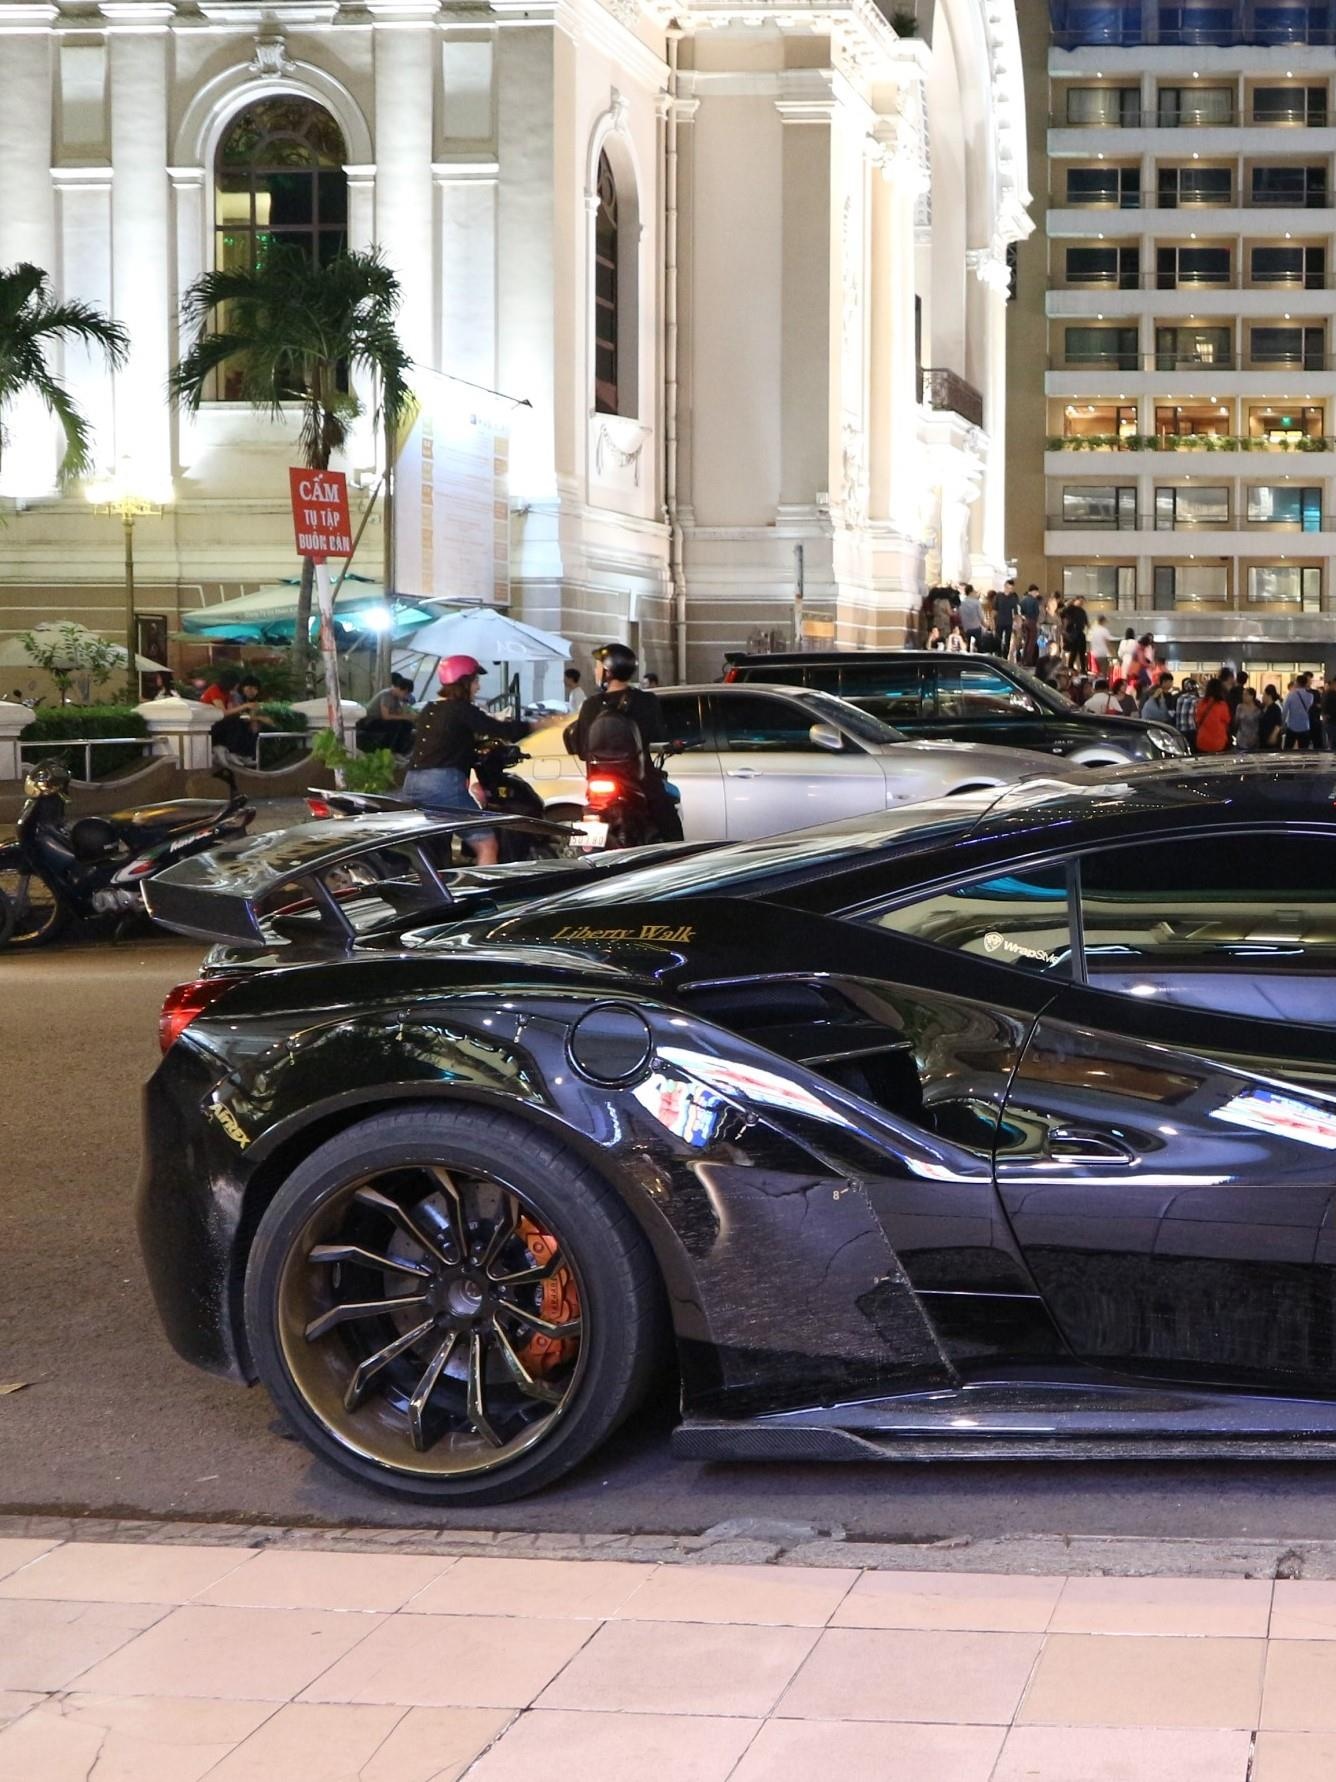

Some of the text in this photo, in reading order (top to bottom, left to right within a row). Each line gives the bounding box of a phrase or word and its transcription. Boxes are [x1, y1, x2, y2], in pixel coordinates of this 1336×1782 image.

[299, 473, 340, 503] CẤM
[304, 508, 340, 531] TỤ TẬP
[552, 925, 696, 943] Liberty Walk
[832, 1190, 840, 1201] 8
